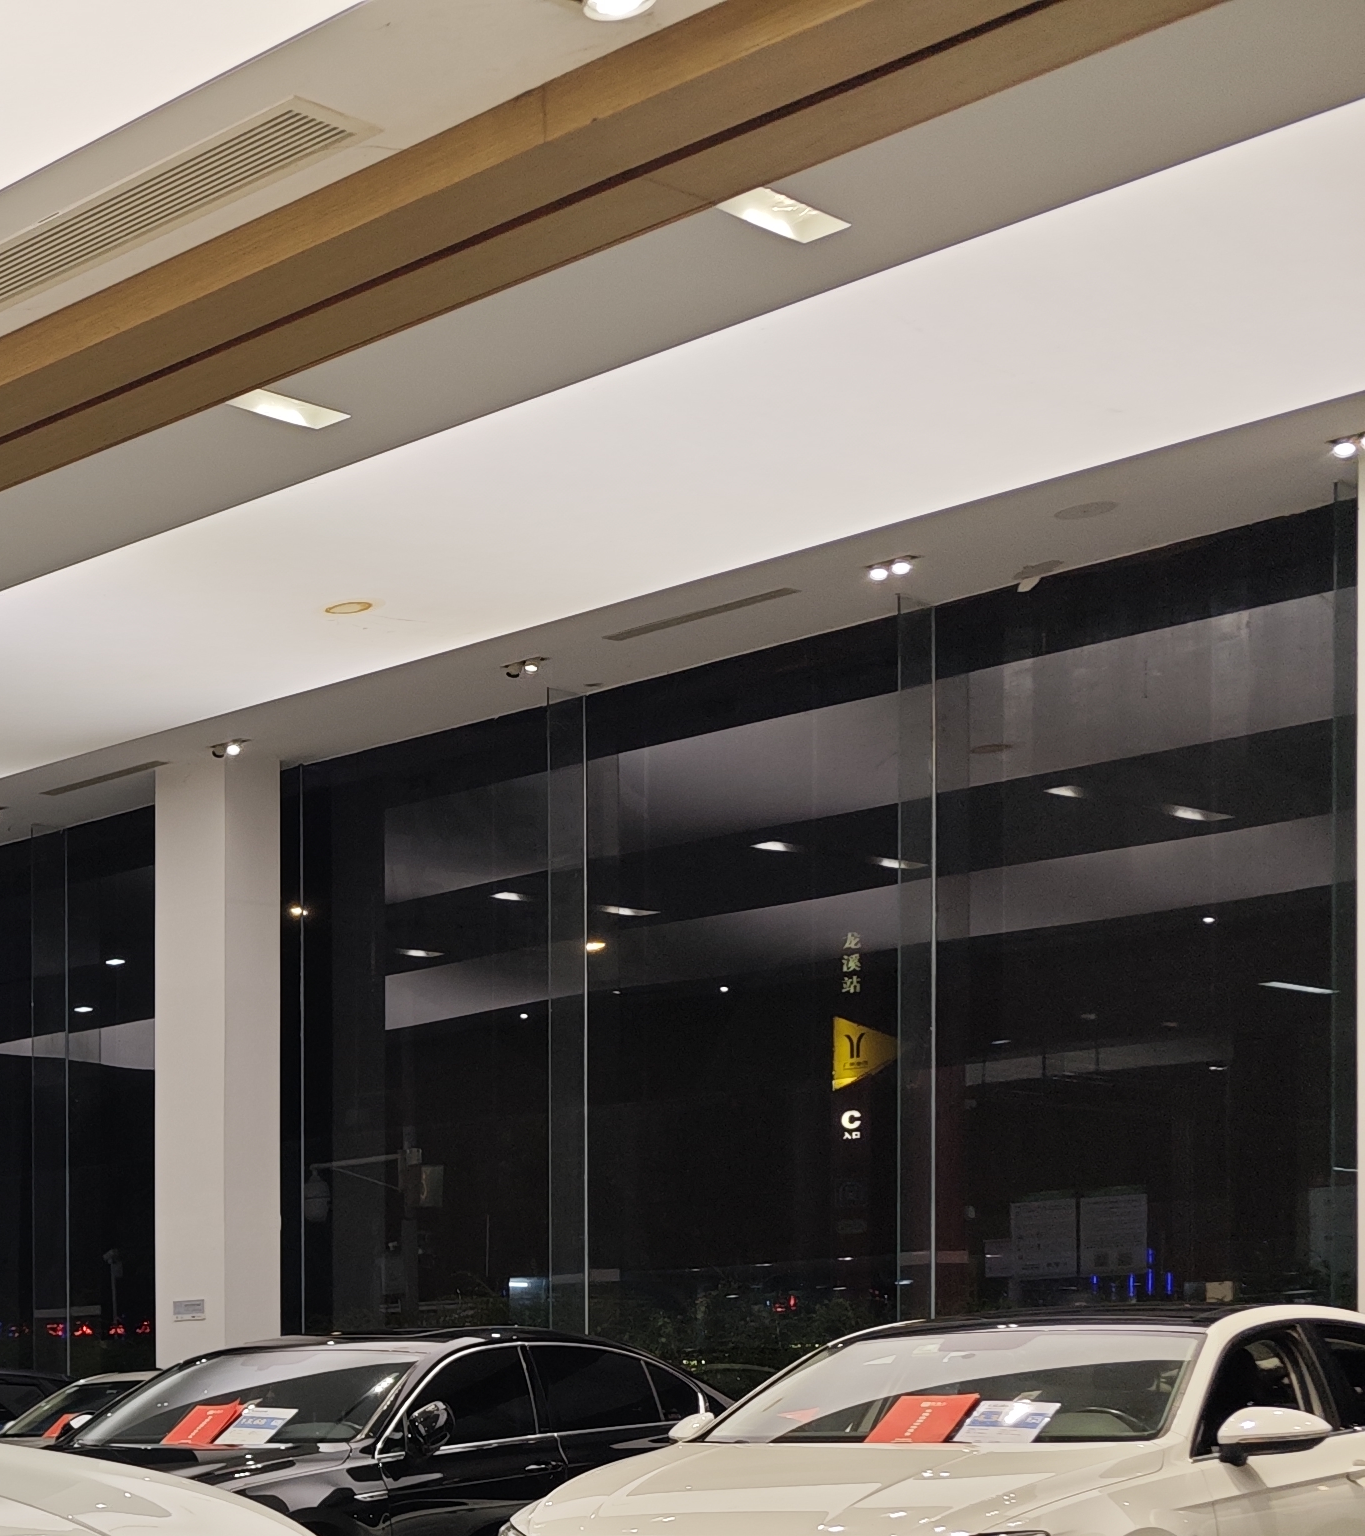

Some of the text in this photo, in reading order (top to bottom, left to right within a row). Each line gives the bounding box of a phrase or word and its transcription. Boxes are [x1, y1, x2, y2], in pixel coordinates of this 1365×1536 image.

[841, 931, 862, 994] 龙溪站
[841, 1110, 862, 1129] C
